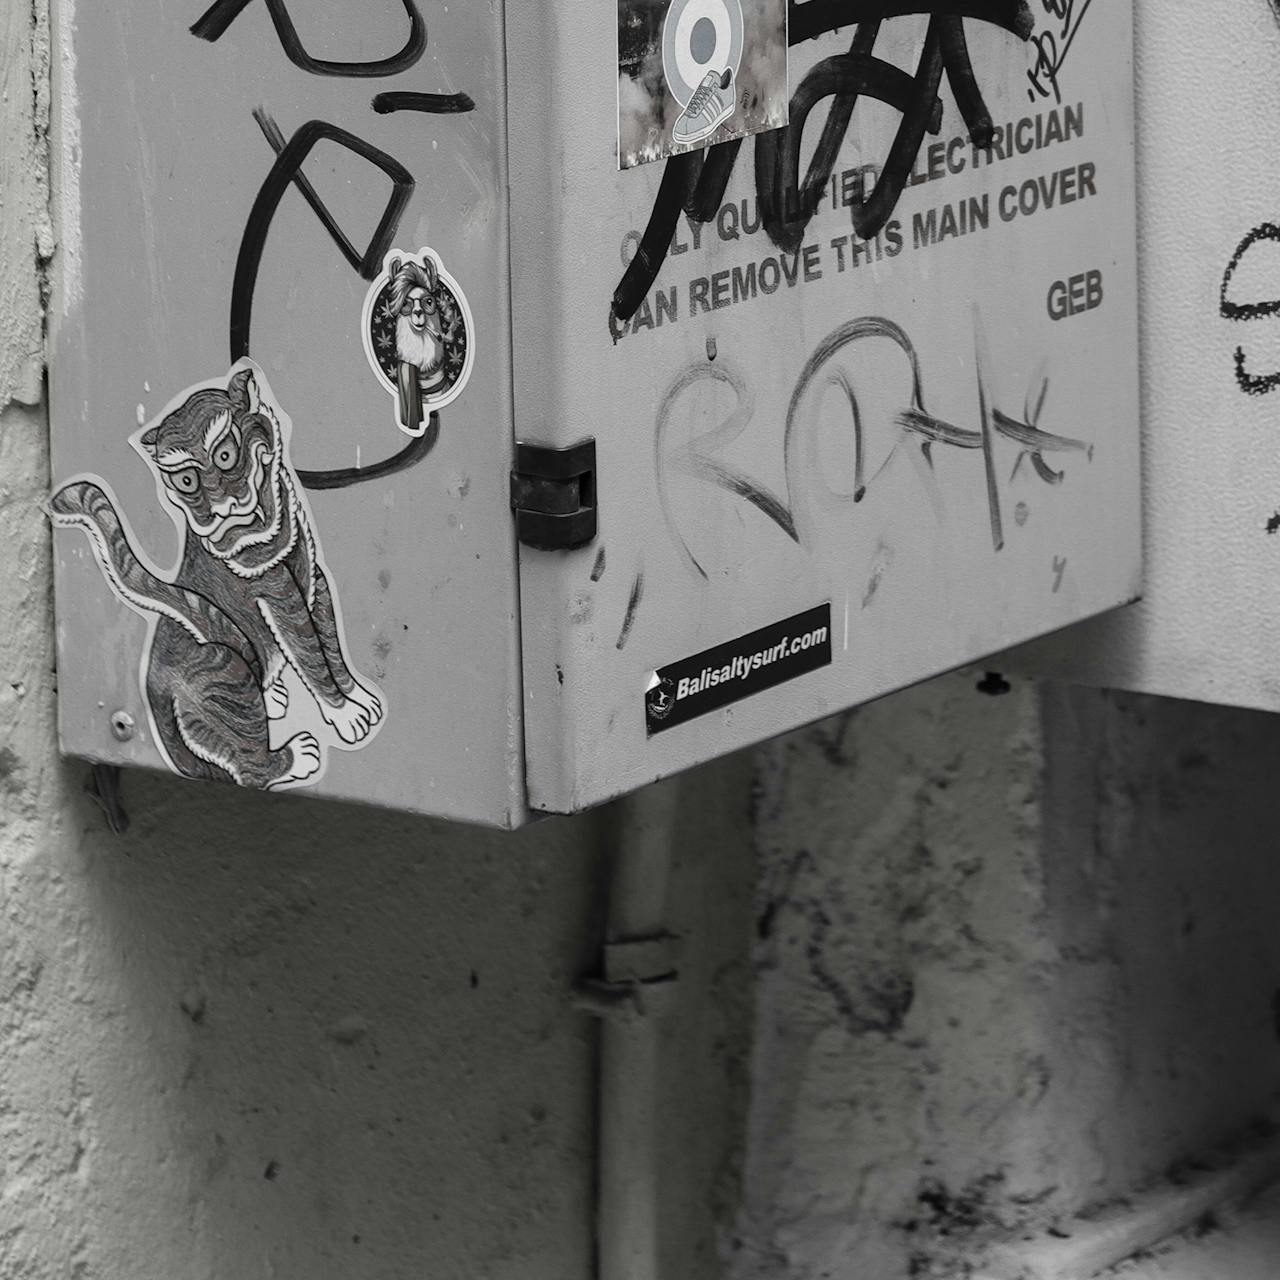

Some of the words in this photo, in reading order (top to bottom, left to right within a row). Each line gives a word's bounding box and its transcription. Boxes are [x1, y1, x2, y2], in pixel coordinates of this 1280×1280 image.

[620, 212, 705, 268] OLY
[906, 102, 1084, 188] ECTRICIAN
[688, 244, 823, 317] REMOVE
[831, 220, 905, 273] THIS
[911, 193, 991, 250] MAIN
[998, 161, 1098, 222] COVER
[1047, 268, 1104, 321] GEB
[676, 624, 828, 701] Balisaltysurf.com
